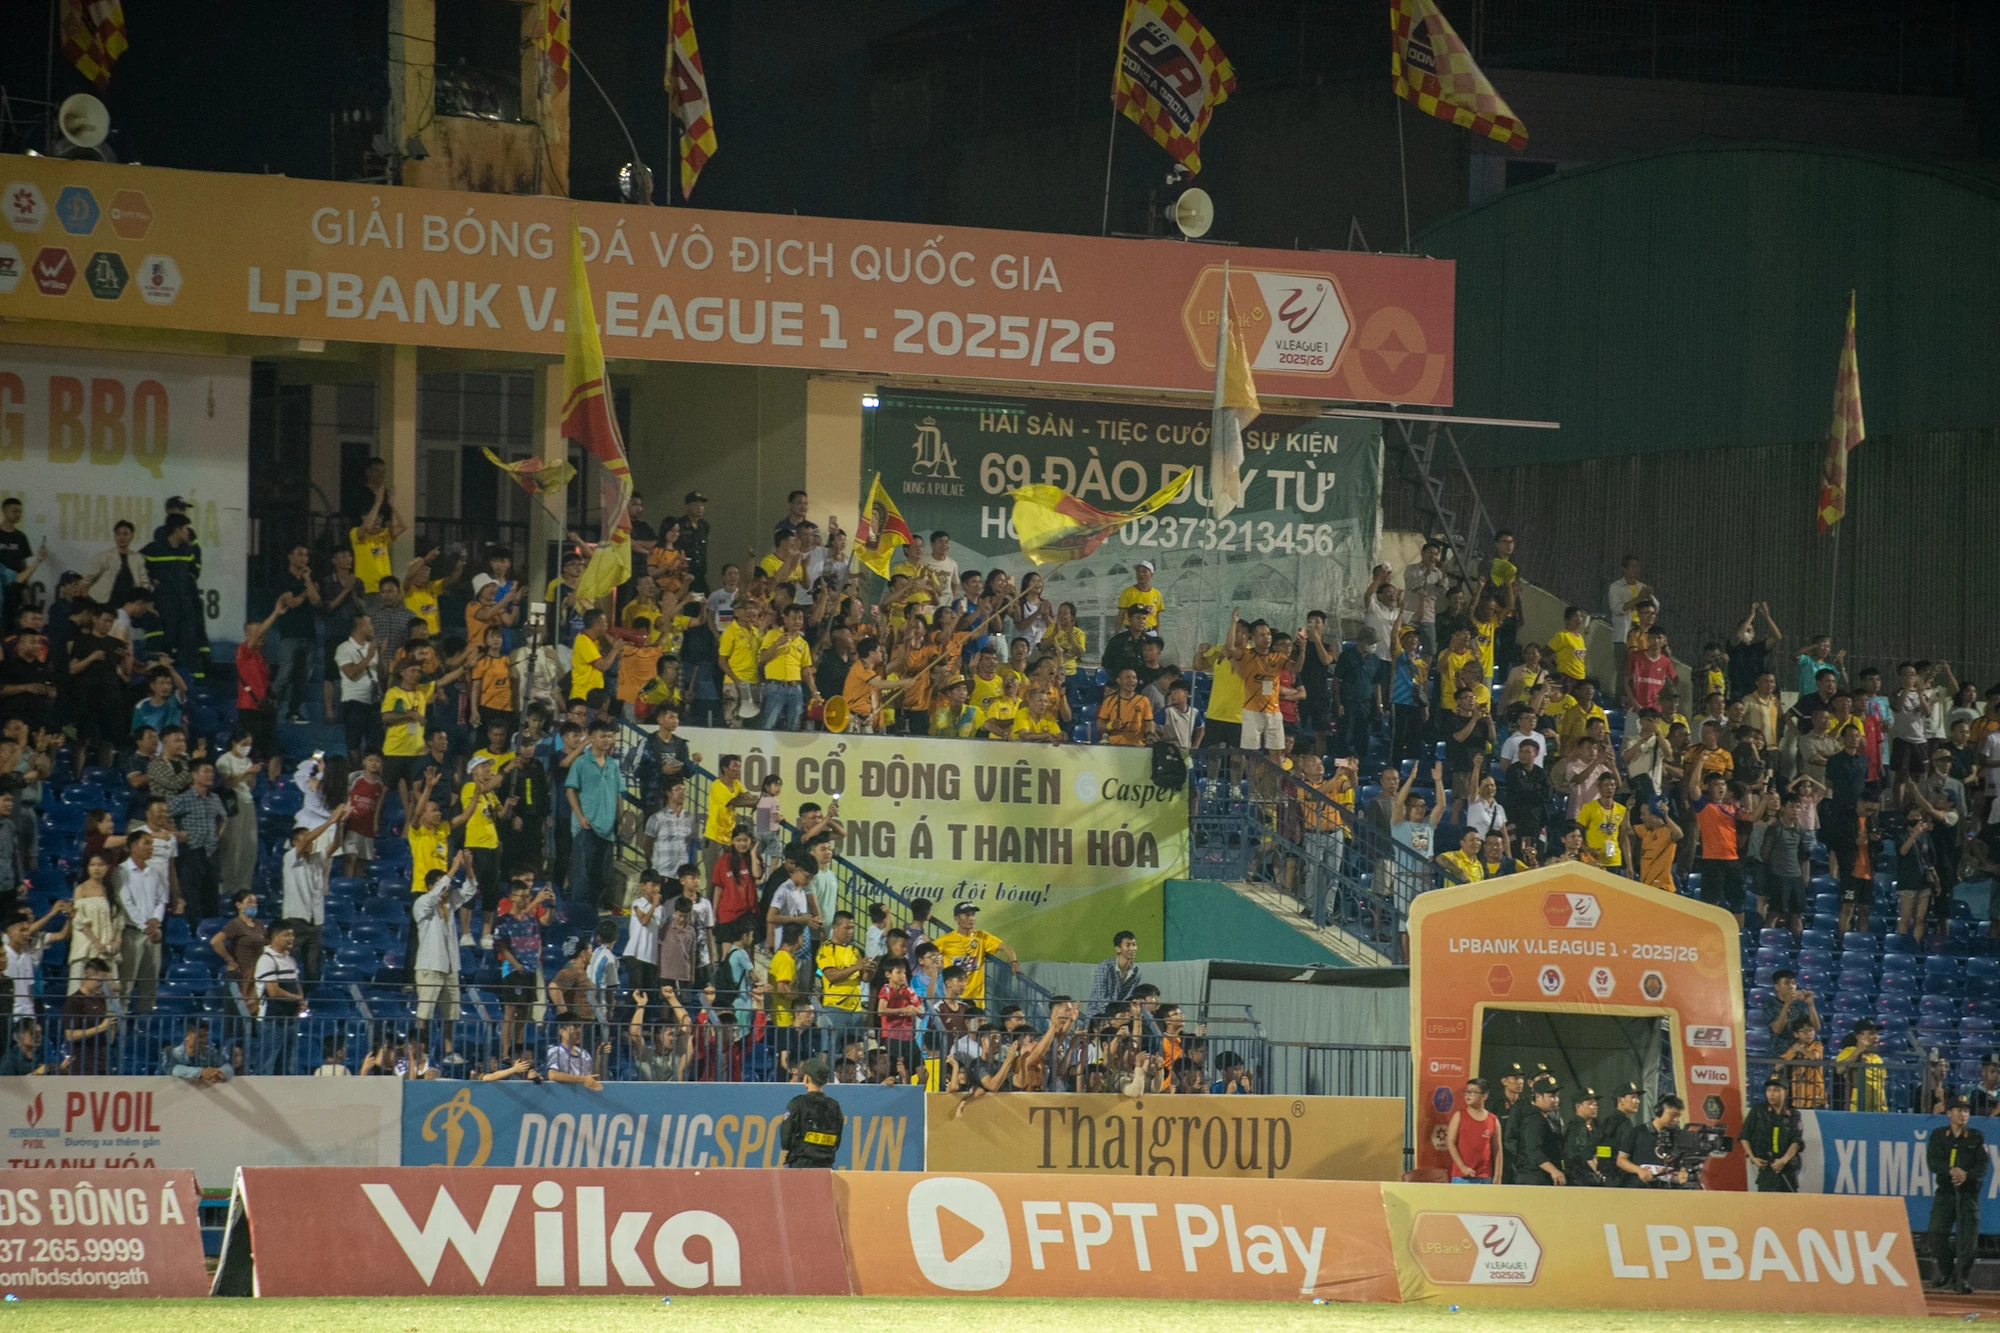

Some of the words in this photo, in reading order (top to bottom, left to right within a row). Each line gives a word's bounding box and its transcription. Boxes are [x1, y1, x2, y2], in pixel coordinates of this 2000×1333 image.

[1408, 47, 1436, 68] DON
[311, 196, 405, 249] GIẢI
[423, 207, 554, 261] BÓNG
[577, 218, 635, 266] ĐÁ
[649, 224, 714, 270] VÔ
[729, 237, 834, 283] ĐỊCH
[850, 234, 976, 287] QUỐC
[990, 254, 1063, 293] GIA
[247, 266, 501, 330] LPBANK
[518, 284, 804, 347] V.EAGUE
[820, 305, 848, 349] 1
[893, 309, 1116, 367] 2025/26
[1275, 340, 1323, 353] V.LEAGUE
[1279, 353, 1324, 366] 2025/26
[48, 375, 169, 479] BBQ
[1026, 412, 1074, 437] SẢN
[1097, 419, 1148, 445] TIỆC
[1156, 422, 1211, 446] CƯỚ
[1246, 431, 1280, 455] SỰ
[1286, 432, 1338, 457] KIỆN
[935, 481, 965, 496] PALACE
[980, 452, 1031, 495] 69
[1041, 446, 1148, 503] ĐÀO
[1267, 460, 1335, 513] TỪ
[1119, 515, 1333, 557] 02373213456
[796, 743, 847, 796] CỔ
[859, 754, 961, 807] ĐỘNG
[974, 759, 1061, 805] VIÊN
[910, 814, 933, 860] Á
[948, 824, 1073, 865] THANH
[1087, 822, 1160, 868] HÓA
[901, 881, 944, 903] cùng
[995, 882, 1051, 907] bóng!
[1449, 937, 1520, 954] LPBANK
[1523, 939, 1606, 957] V.LEAGUE
[1610, 942, 1619, 957] 1
[1632, 943, 1699, 962] 2025/26
[1694, 1069, 1728, 1081] Wika
[65, 1091, 161, 1133] PVOIL
[116, 1137, 140, 1146] thêm
[514, 1112, 908, 1171] DONGLUCSPO.VN
[1834, 1139, 1867, 1194] XI
[1878, 1130, 1938, 1197] MĂ
[49, 1181, 149, 1226] ĐÔNG
[160, 1180, 186, 1226] Á
[0, 1238, 145, 1263] 37.265.9999
[361, 1180, 742, 1289] Wika
[1021, 1201, 1158, 1272] FPT
[1175, 1203, 1327, 1295] Play
[1420, 1242, 1463, 1255] LPBank
[1603, 1223, 1908, 1288] LPBANK
[1489, 1271, 1526, 1280] 2025/26
